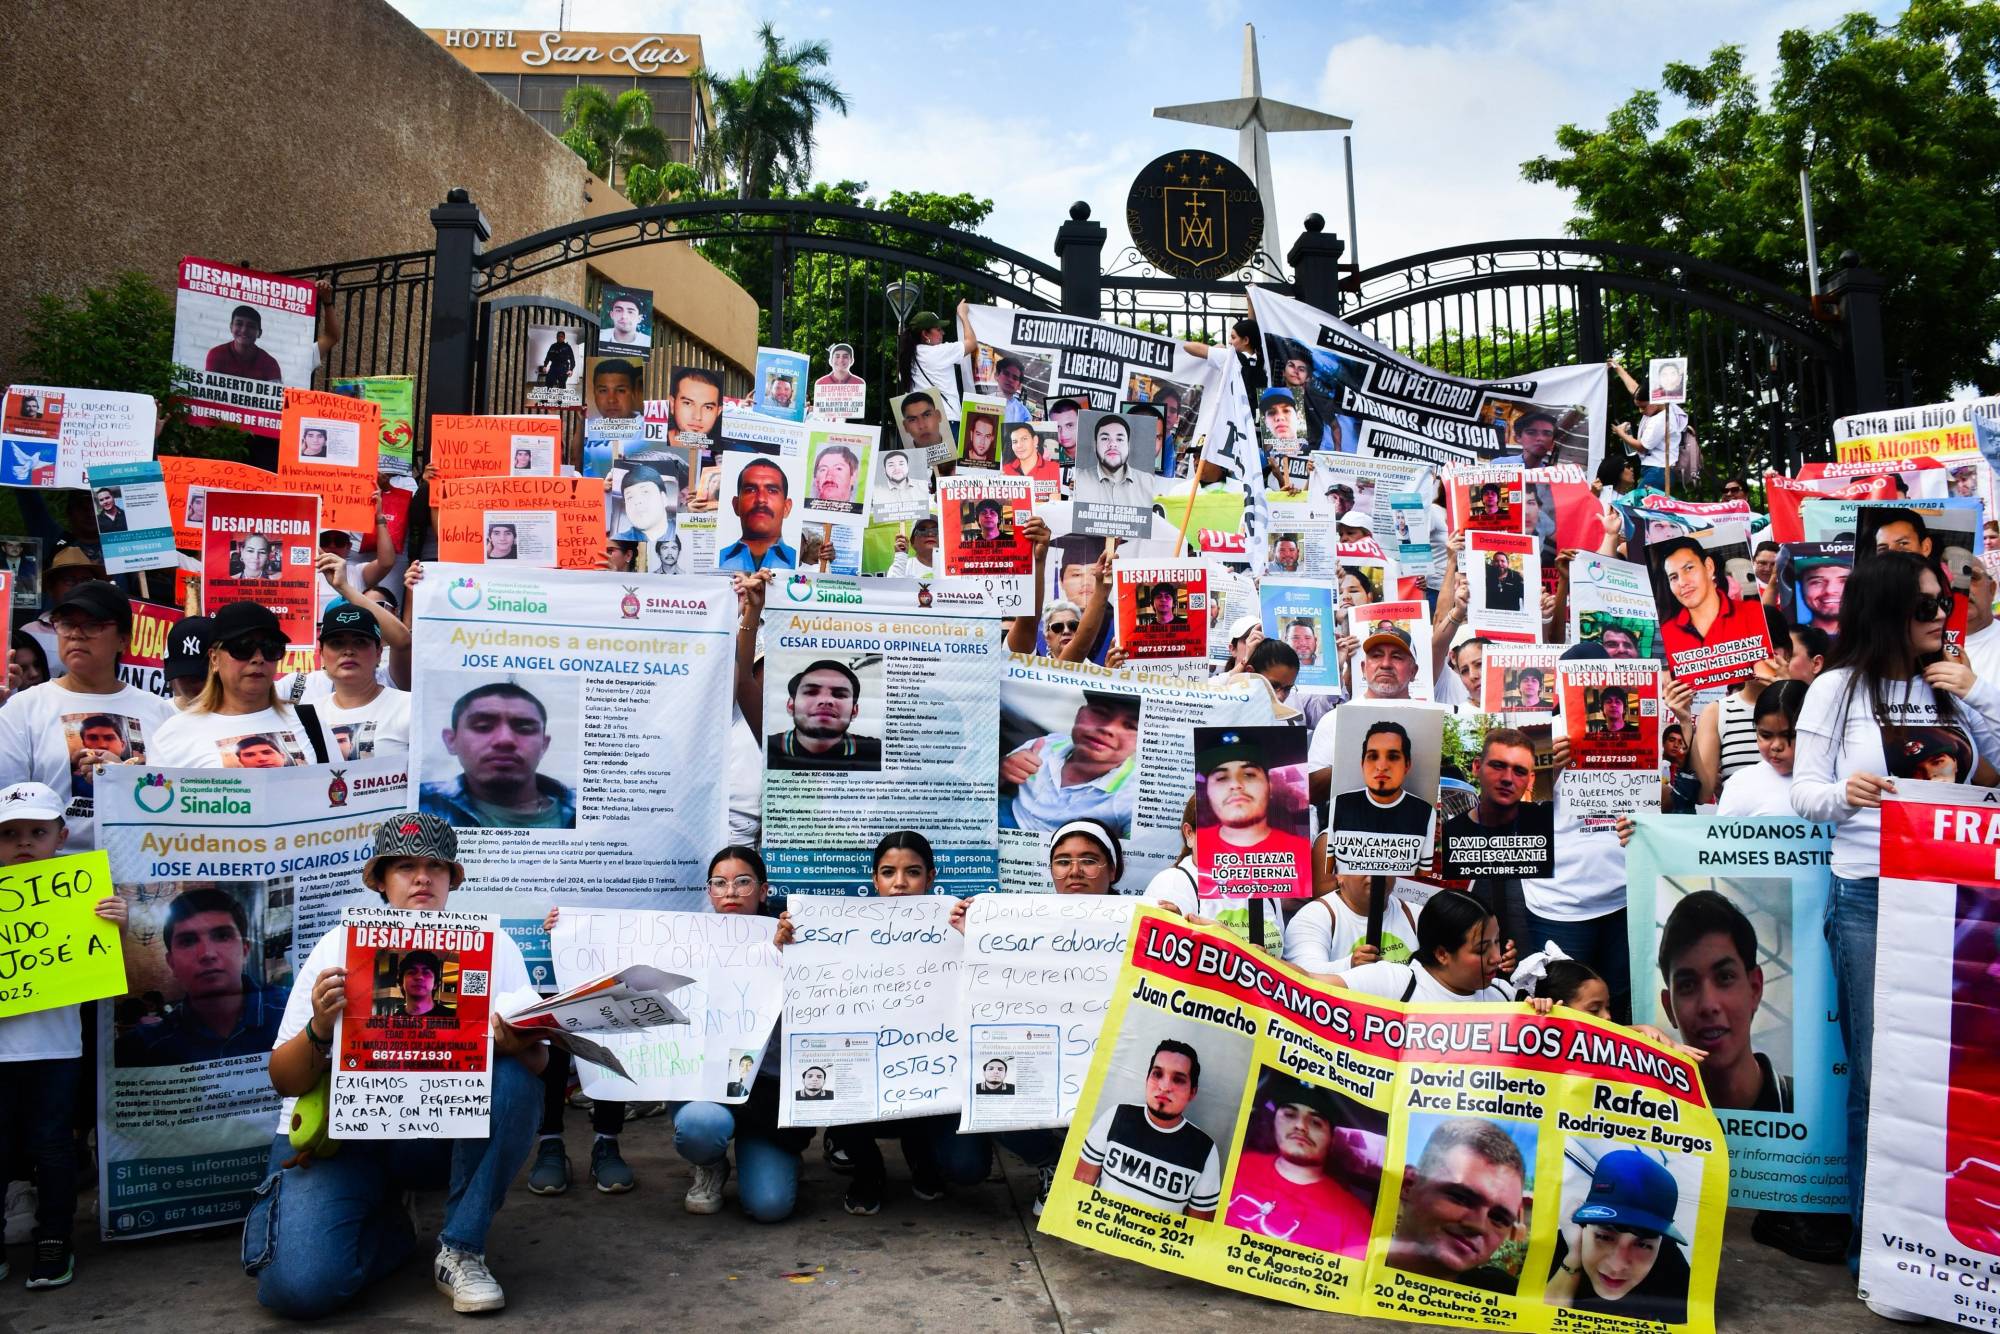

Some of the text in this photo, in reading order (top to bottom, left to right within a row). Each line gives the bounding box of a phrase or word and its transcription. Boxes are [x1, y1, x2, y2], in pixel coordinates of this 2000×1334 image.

[444, 30, 690, 73] HOTEL San Luis
[185, 264, 313, 304] ¡DESAPARECIDO!
[190, 280, 306, 313] DESDE 16 DE ENERO DEL 2025
[1017, 319, 1170, 367] ESTUDIANTE PRIVADO DE LA
[1063, 353, 1119, 383] LIBERTAD
[206, 374, 270, 395] ALBERTO DE
[1378, 368, 1474, 411] UN PELIGRO!
[1342, 386, 1501, 450] EXIGIMOS JUSTICIA
[438, 440, 492, 454] VIVO SE
[1372, 432, 1472, 466] AYUDANOS A LOCALIZAR
[1877, 437, 1940, 459] Alfonso
[1329, 467, 1416, 482] MANUEL LOZOYA GUERRERO
[946, 487, 1026, 500] DESAPARECIDO
[1078, 511, 1147, 523] AGUILAR RODRIGUEZ
[1089, 504, 1137, 515] MARCO CESAR
[212, 516, 311, 535] DESAPARECIDA
[567, 526, 583, 535] TE
[442, 527, 483, 543] 16/01/25
[558, 537, 597, 547] ESPERA
[560, 556, 596, 566] CASA
[572, 548, 586, 556] EN
[964, 561, 1014, 569] 6671571930
[1122, 571, 1202, 583] DESAPARECIDO
[488, 597, 548, 613] Sinaloa
[646, 598, 707, 609] SINALOA
[817, 591, 863, 604] Sinaloa
[789, 616, 984, 637] Ayúdanos a encontrar a
[780, 637, 988, 655] CESAR EDUARDO ORPINELA TORRES
[1672, 635, 1763, 663] VICTOR JOHBANY
[462, 654, 689, 676] JOSE ANGEL GONZALEZ SALAS
[1674, 648, 1769, 676] MARIN MELENDREZ
[1008, 668, 1043, 681] JOEL
[1047, 674, 1106, 689] ISRRAEL
[1111, 683, 1180, 696] NOLASCO
[1568, 672, 1652, 686] DESAPARECIDO
[1694, 667, 1753, 686] 04-JULIO-2024
[353, 772, 407, 790] SINALOA
[1564, 773, 1661, 788] EXIGIMOS JUSTICIA
[1579, 788, 1624, 798] QUEREMOS
[1630, 788, 1642, 796] DE
[181, 797, 251, 814] Sinaloa
[1706, 822, 1823, 841] AYÚDANOS A
[1334, 837, 1421, 847] JUAN CAMACHO
[1450, 835, 1547, 849] DAVID GILBERTO
[150, 852, 349, 877] JOSE ALBERTO SICAIROS
[1214, 852, 1295, 866] FCO. ELEAZAR
[1450, 850, 1547, 862] ARCE ESCALANTE
[1698, 851, 1769, 866] RAMSES
[1212, 866, 1298, 880] LÓPEZ BERNAL
[1349, 862, 1411, 871] 12-MARZO-2021
[1460, 866, 1537, 874] 20-OCTUBRE-2021
[1217, 884, 1292, 894] 13-AGOSTO-2021
[348, 908, 411, 917] ESTUDIANTE
[343, 920, 480, 931] CIUDADANO AMERICANO
[356, 929, 485, 951] DESAPARECIDO
[1002, 965, 1108, 987] queremos
[972, 1001, 1048, 1021] regreso
[1133, 977, 1256, 1035] Juan Camacho
[1146, 929, 1194, 967] LOS
[1198, 945, 1358, 1040] BUSCAMOS,
[1363, 1013, 1492, 1053] PORQUE
[1499, 1022, 1561, 1058] LOS
[1567, 1032, 1690, 1092] AMAMOS
[372, 1050, 451, 1061] 6671571930
[1267, 1019, 1394, 1083] Francisco Eleazar
[1279, 1046, 1374, 1098] López Bernal
[336, 1076, 485, 1092] EXIGIMOS JUSTICIA
[1410, 1068, 1546, 1096] David Gilberto
[334, 1094, 491, 1105] POR FAVOR REGRESAME
[1408, 1089, 1543, 1119] Arce Escalante
[1593, 1085, 1678, 1122] Rafael
[335, 1107, 490, 1118] A CASA, CON MI FAMILIA
[335, 1123, 368, 1131] SANO
[1558, 1113, 1712, 1152] Rodriguez Burgos
[1106, 1147, 1196, 1195] SWAGGY
[1090, 1190, 1187, 1230] Desapareció el
[1076, 1200, 1194, 1247] 12 de Marzo 2021
[1076, 1218, 1185, 1260] en Culiacán, Sin.
[1882, 1233, 1983, 1274] Visto por
